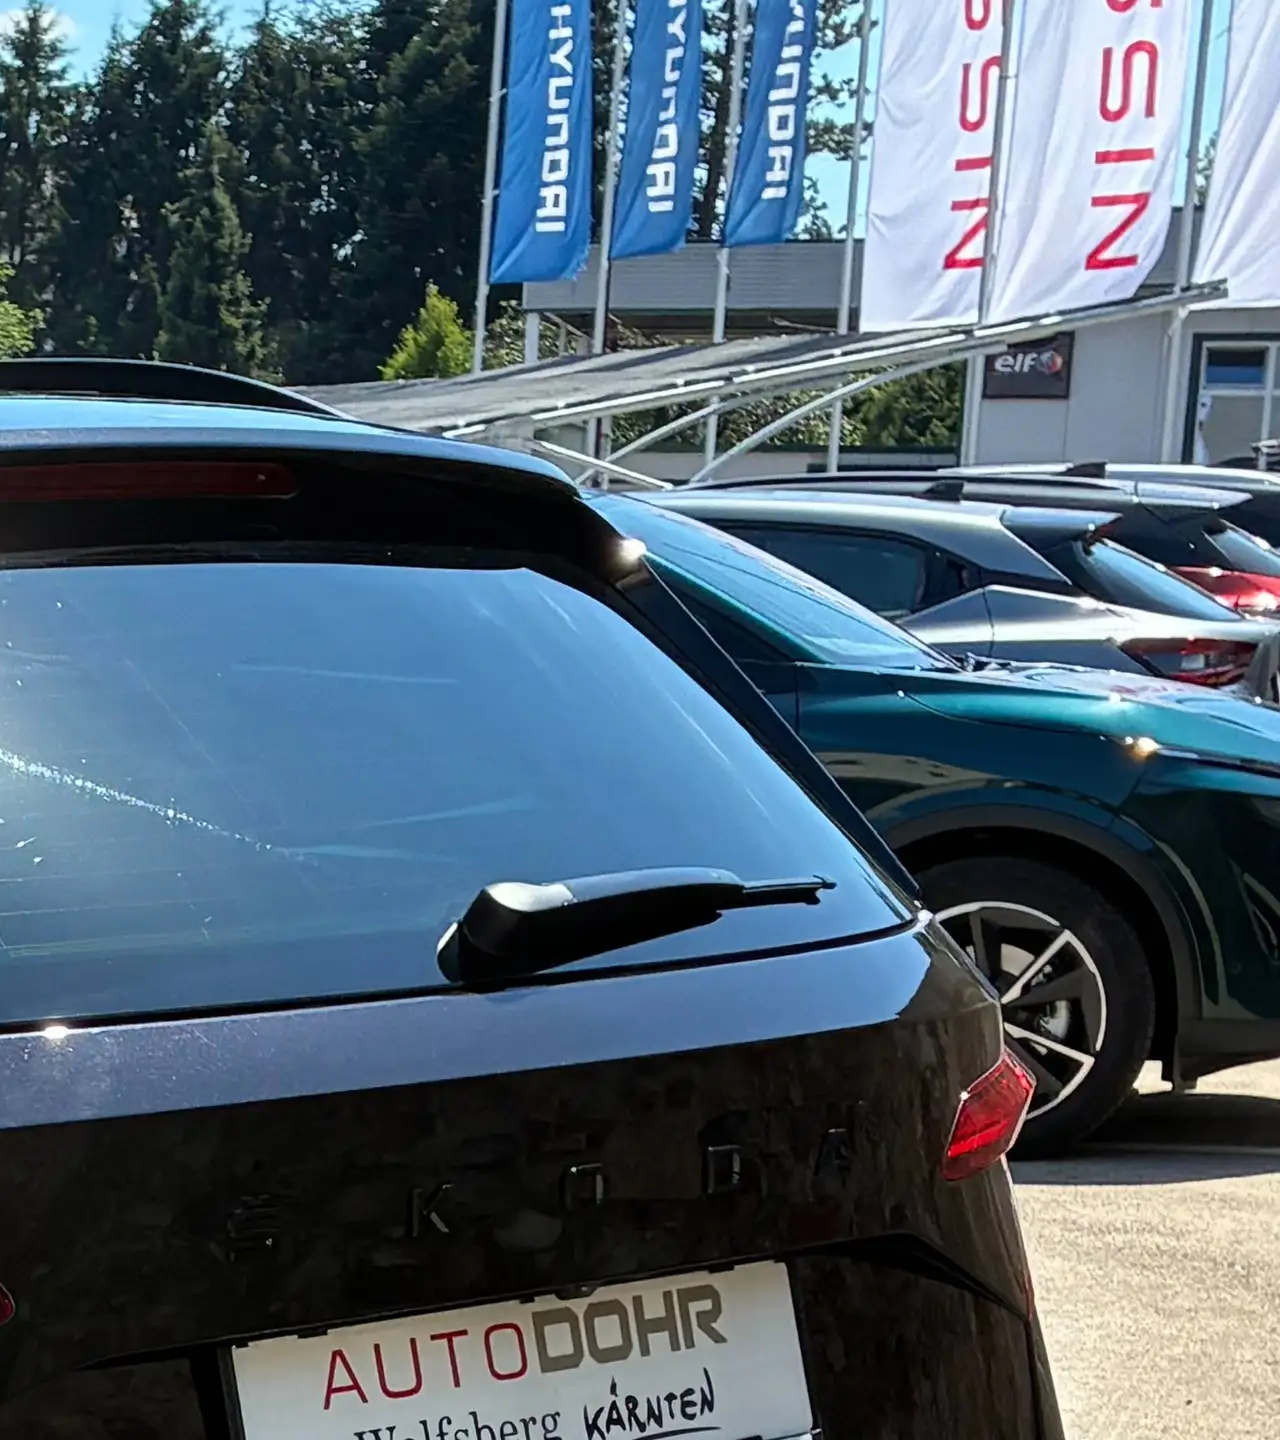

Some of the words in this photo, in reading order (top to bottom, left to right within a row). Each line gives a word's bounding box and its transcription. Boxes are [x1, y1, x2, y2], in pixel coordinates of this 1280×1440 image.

[535, 4, 574, 232] HYUNDAI
[645, 0, 687, 213] YUNDAI
[1084, 0, 1160, 271] NIS
[994, 352, 1039, 373] elf
